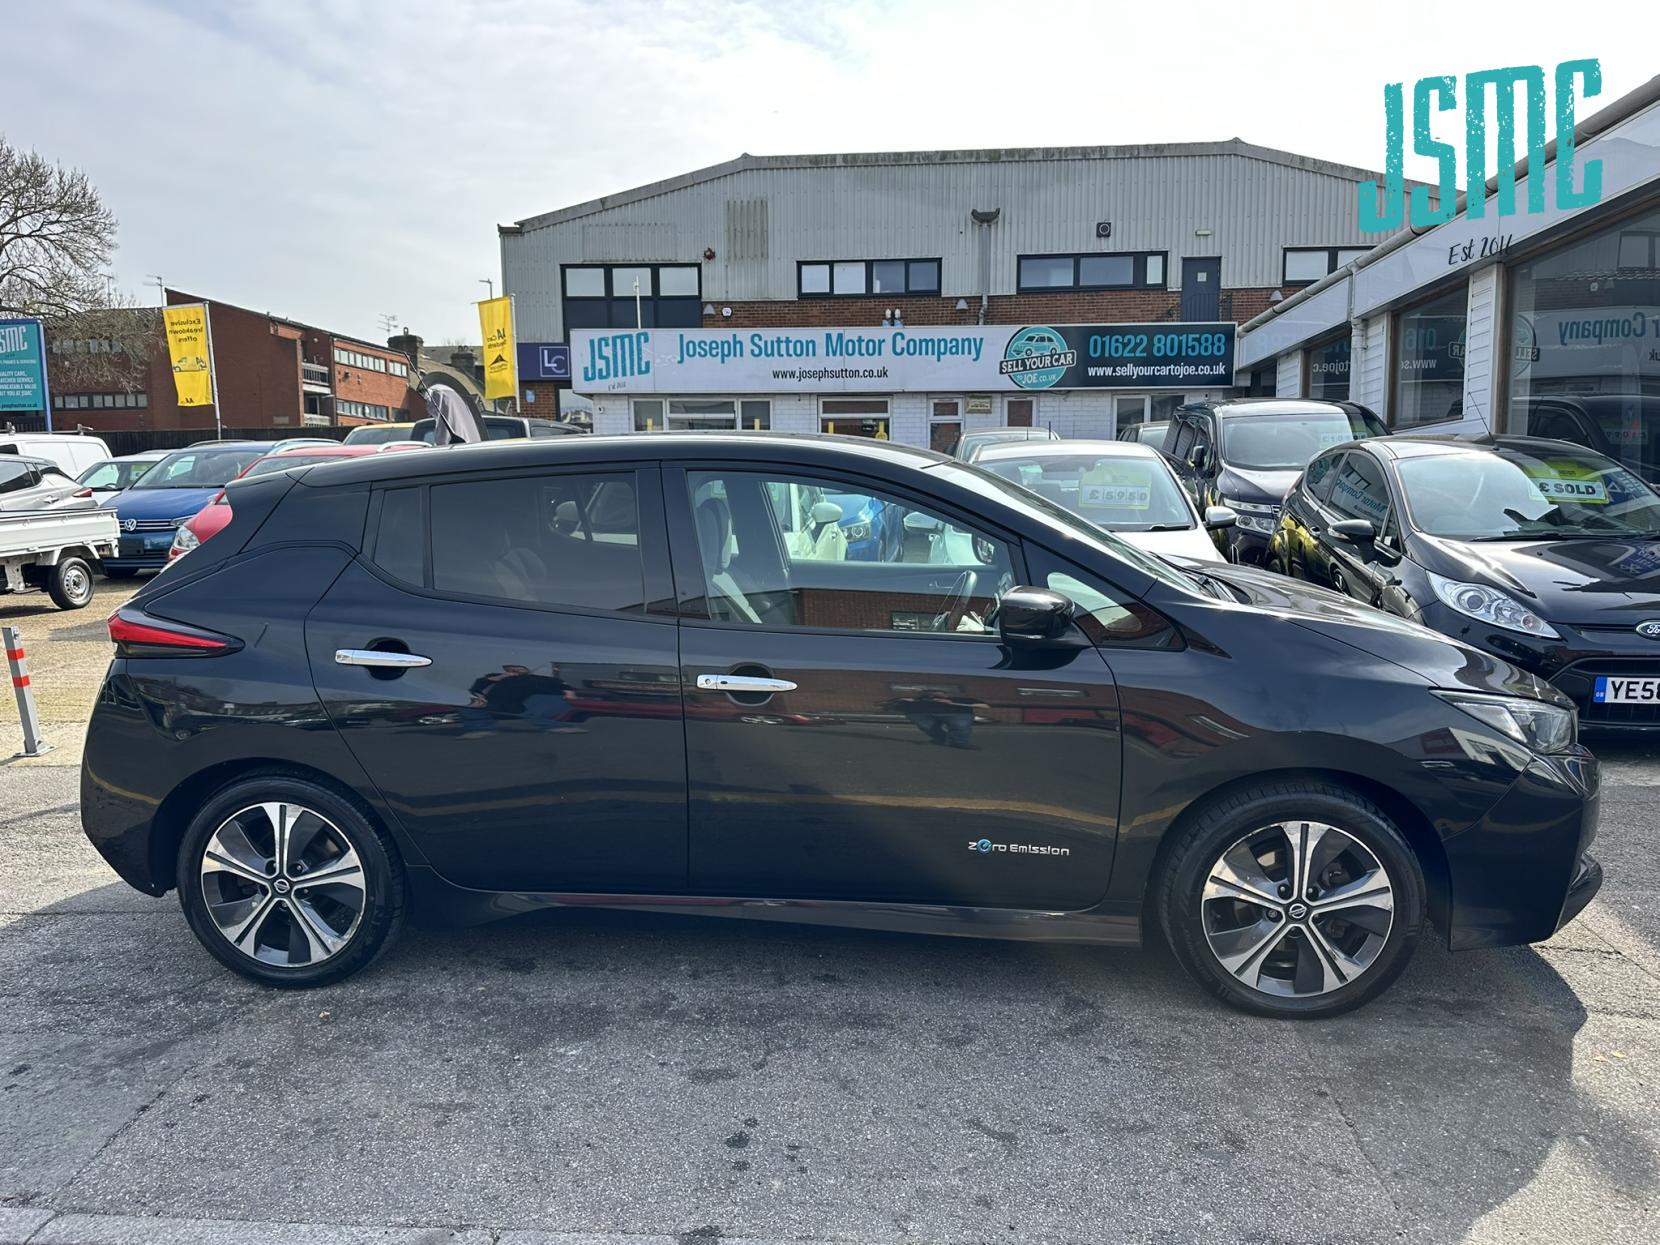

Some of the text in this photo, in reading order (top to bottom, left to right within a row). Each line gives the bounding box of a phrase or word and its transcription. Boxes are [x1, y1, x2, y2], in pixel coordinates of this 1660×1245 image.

[0, 325, 28, 353] SMC
[677, 331, 984, 364] Joseph Sutton Motor Company
[1088, 333, 1226, 358] 01622 801588
[543, 349, 566, 374] LC
[583, 331, 651, 382] JSMC
[1001, 353, 1073, 373] SELL YOUR CAR
[772, 366, 889, 382] www.josephsutton.co.uk
[1087, 362, 1226, 379] www.sellyourcartojoe.co.uk
[1538, 482, 1596, 495] £ SOLD
